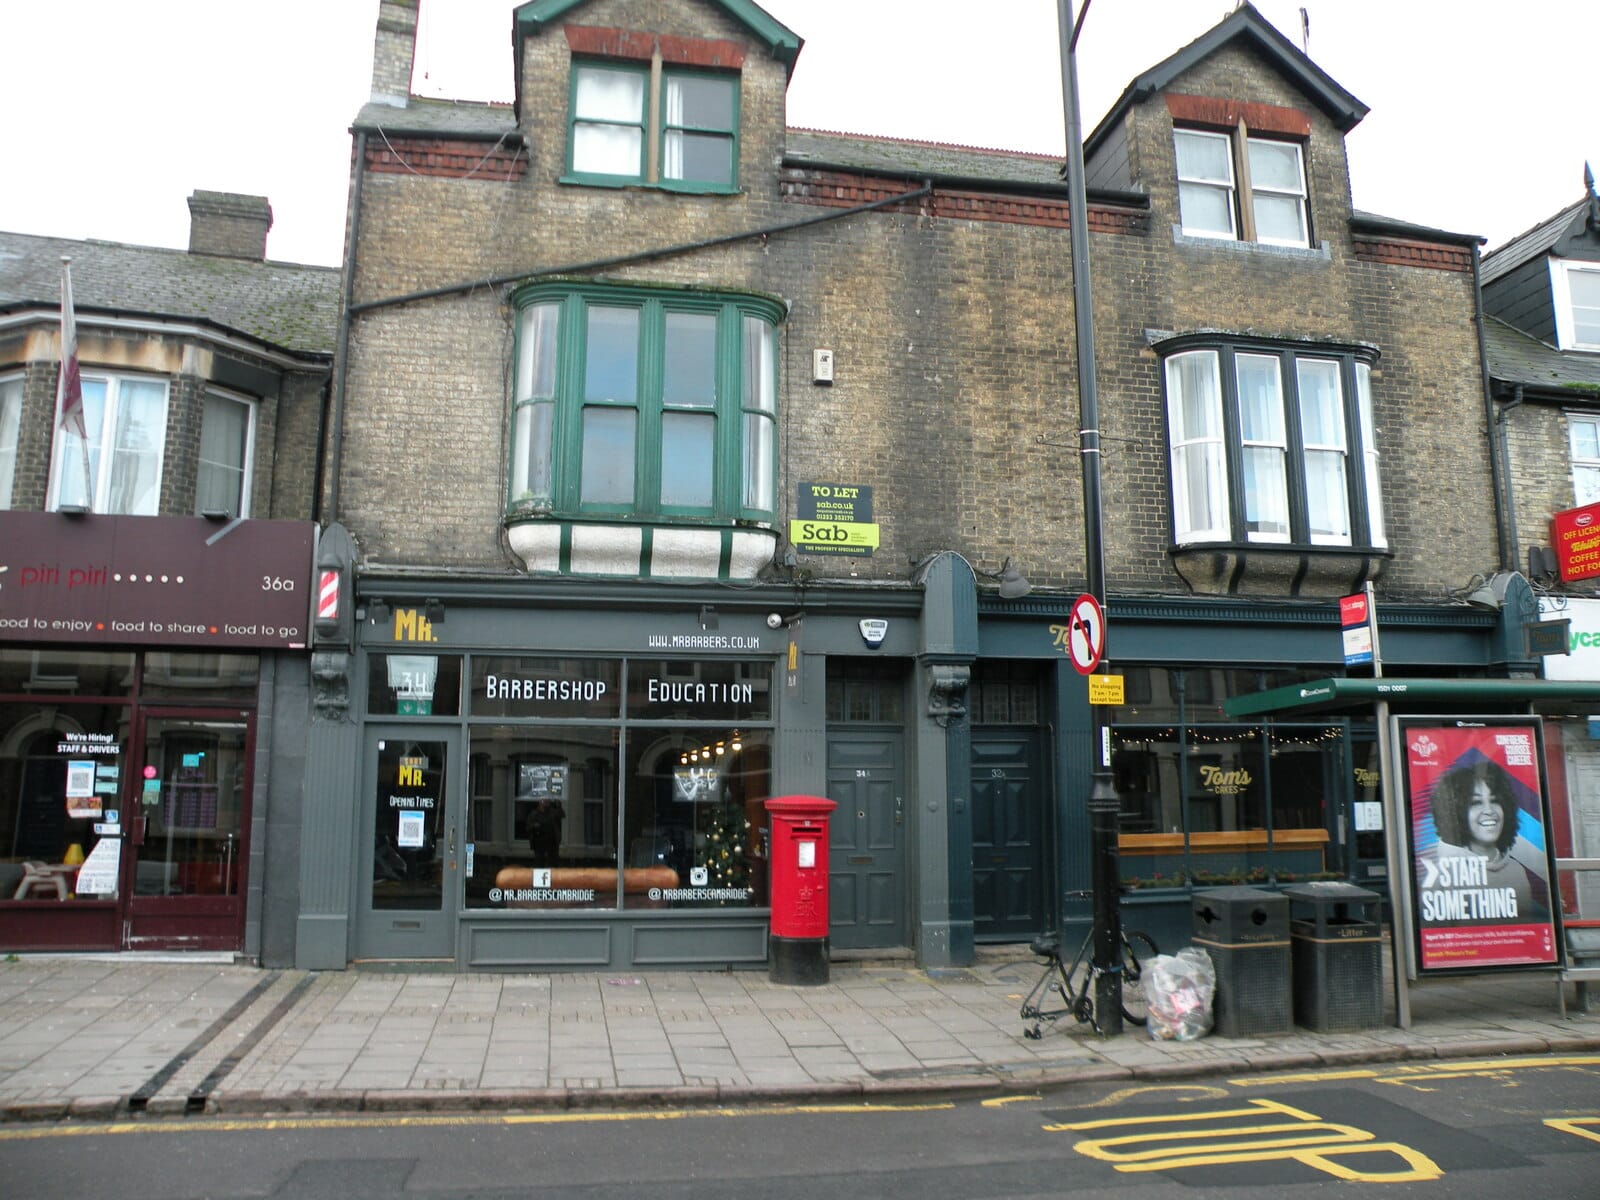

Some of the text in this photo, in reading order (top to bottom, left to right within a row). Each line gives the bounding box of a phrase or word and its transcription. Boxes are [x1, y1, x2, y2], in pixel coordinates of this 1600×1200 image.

[811, 486, 859, 499] TO LET
[816, 501, 854, 510] sab.co.uk
[802, 523, 848, 542] Sab
[1563, 524, 1600, 541] OFF LICEN
[1569, 551, 1599, 564] COFFEE
[20, 563, 108, 590] piri piri
[1567, 564, 1585, 575] HOT
[261, 575, 295, 592] 36a
[34, 618, 48, 628] to
[52, 619, 92, 632] enjoy
[111, 620, 206, 634] food to share
[224, 624, 298, 638] food to go
[648, 635, 760, 649] WWW.MRBARBERS.CO.UK
[402, 671, 426, 697] 34
[486, 675, 606, 701] BARBERSHOP
[648, 678, 752, 703] EDUCATION
[66, 732, 114, 744] We're Hiring!
[57, 744, 120, 754] STAFF & DRIVERS
[1200, 765, 1252, 786] Tom's
[1215, 785, 1239, 794] CAKES
[389, 795, 434, 808] OPENING TIMES
[1438, 855, 1489, 887] START
[1422, 887, 1518, 921] SOMETHING
[1341, 929, 1364, 937] Litter
